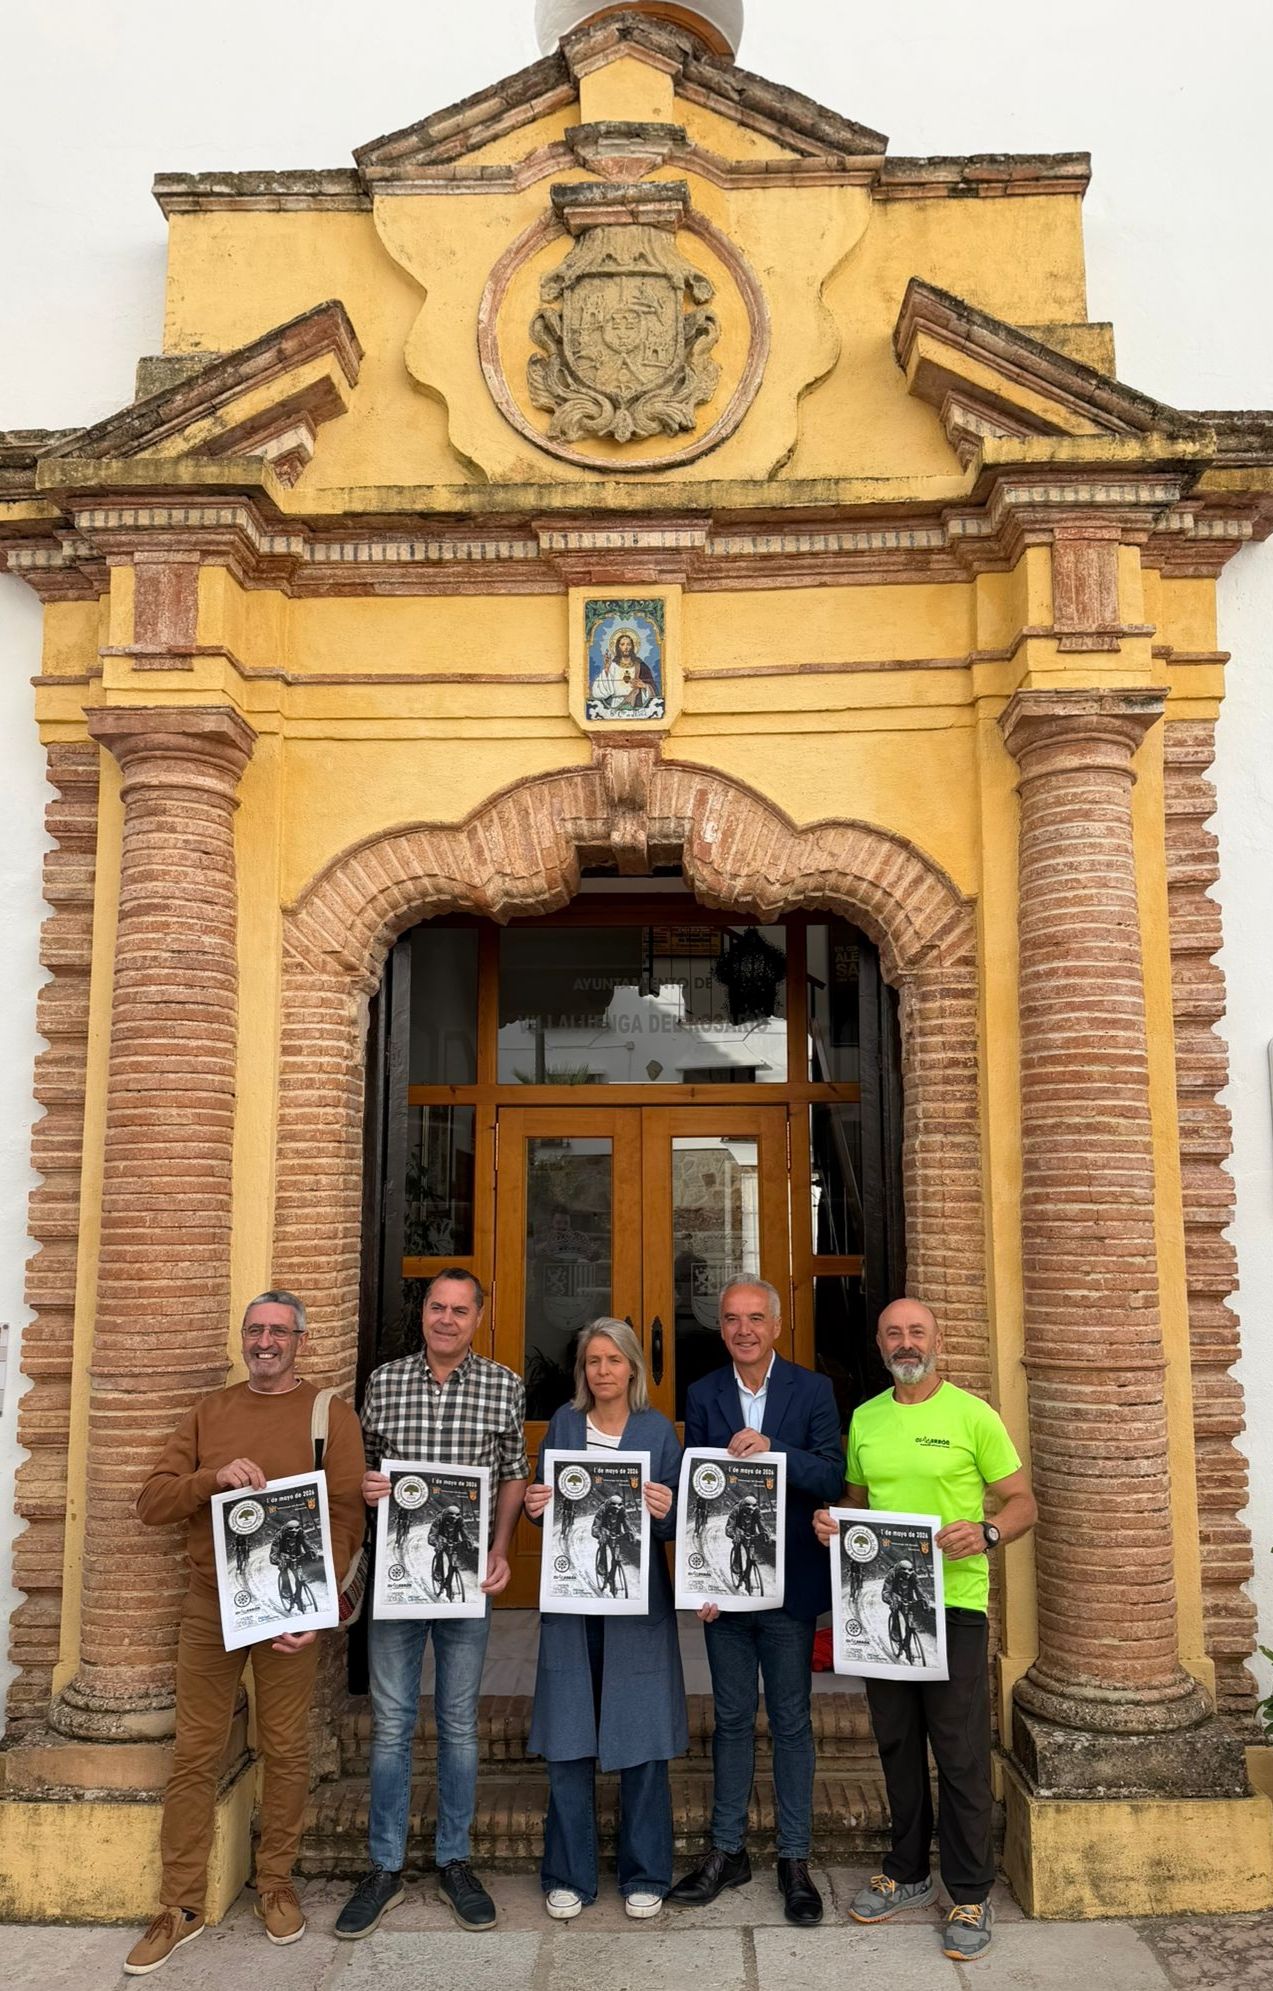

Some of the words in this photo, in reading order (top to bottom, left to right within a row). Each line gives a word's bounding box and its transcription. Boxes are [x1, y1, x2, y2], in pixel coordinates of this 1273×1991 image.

[573, 977, 689, 991] AYUNTAMIENTO
[648, 1014, 684, 1034] DEL
[893, 1530, 907, 1538] mayo
